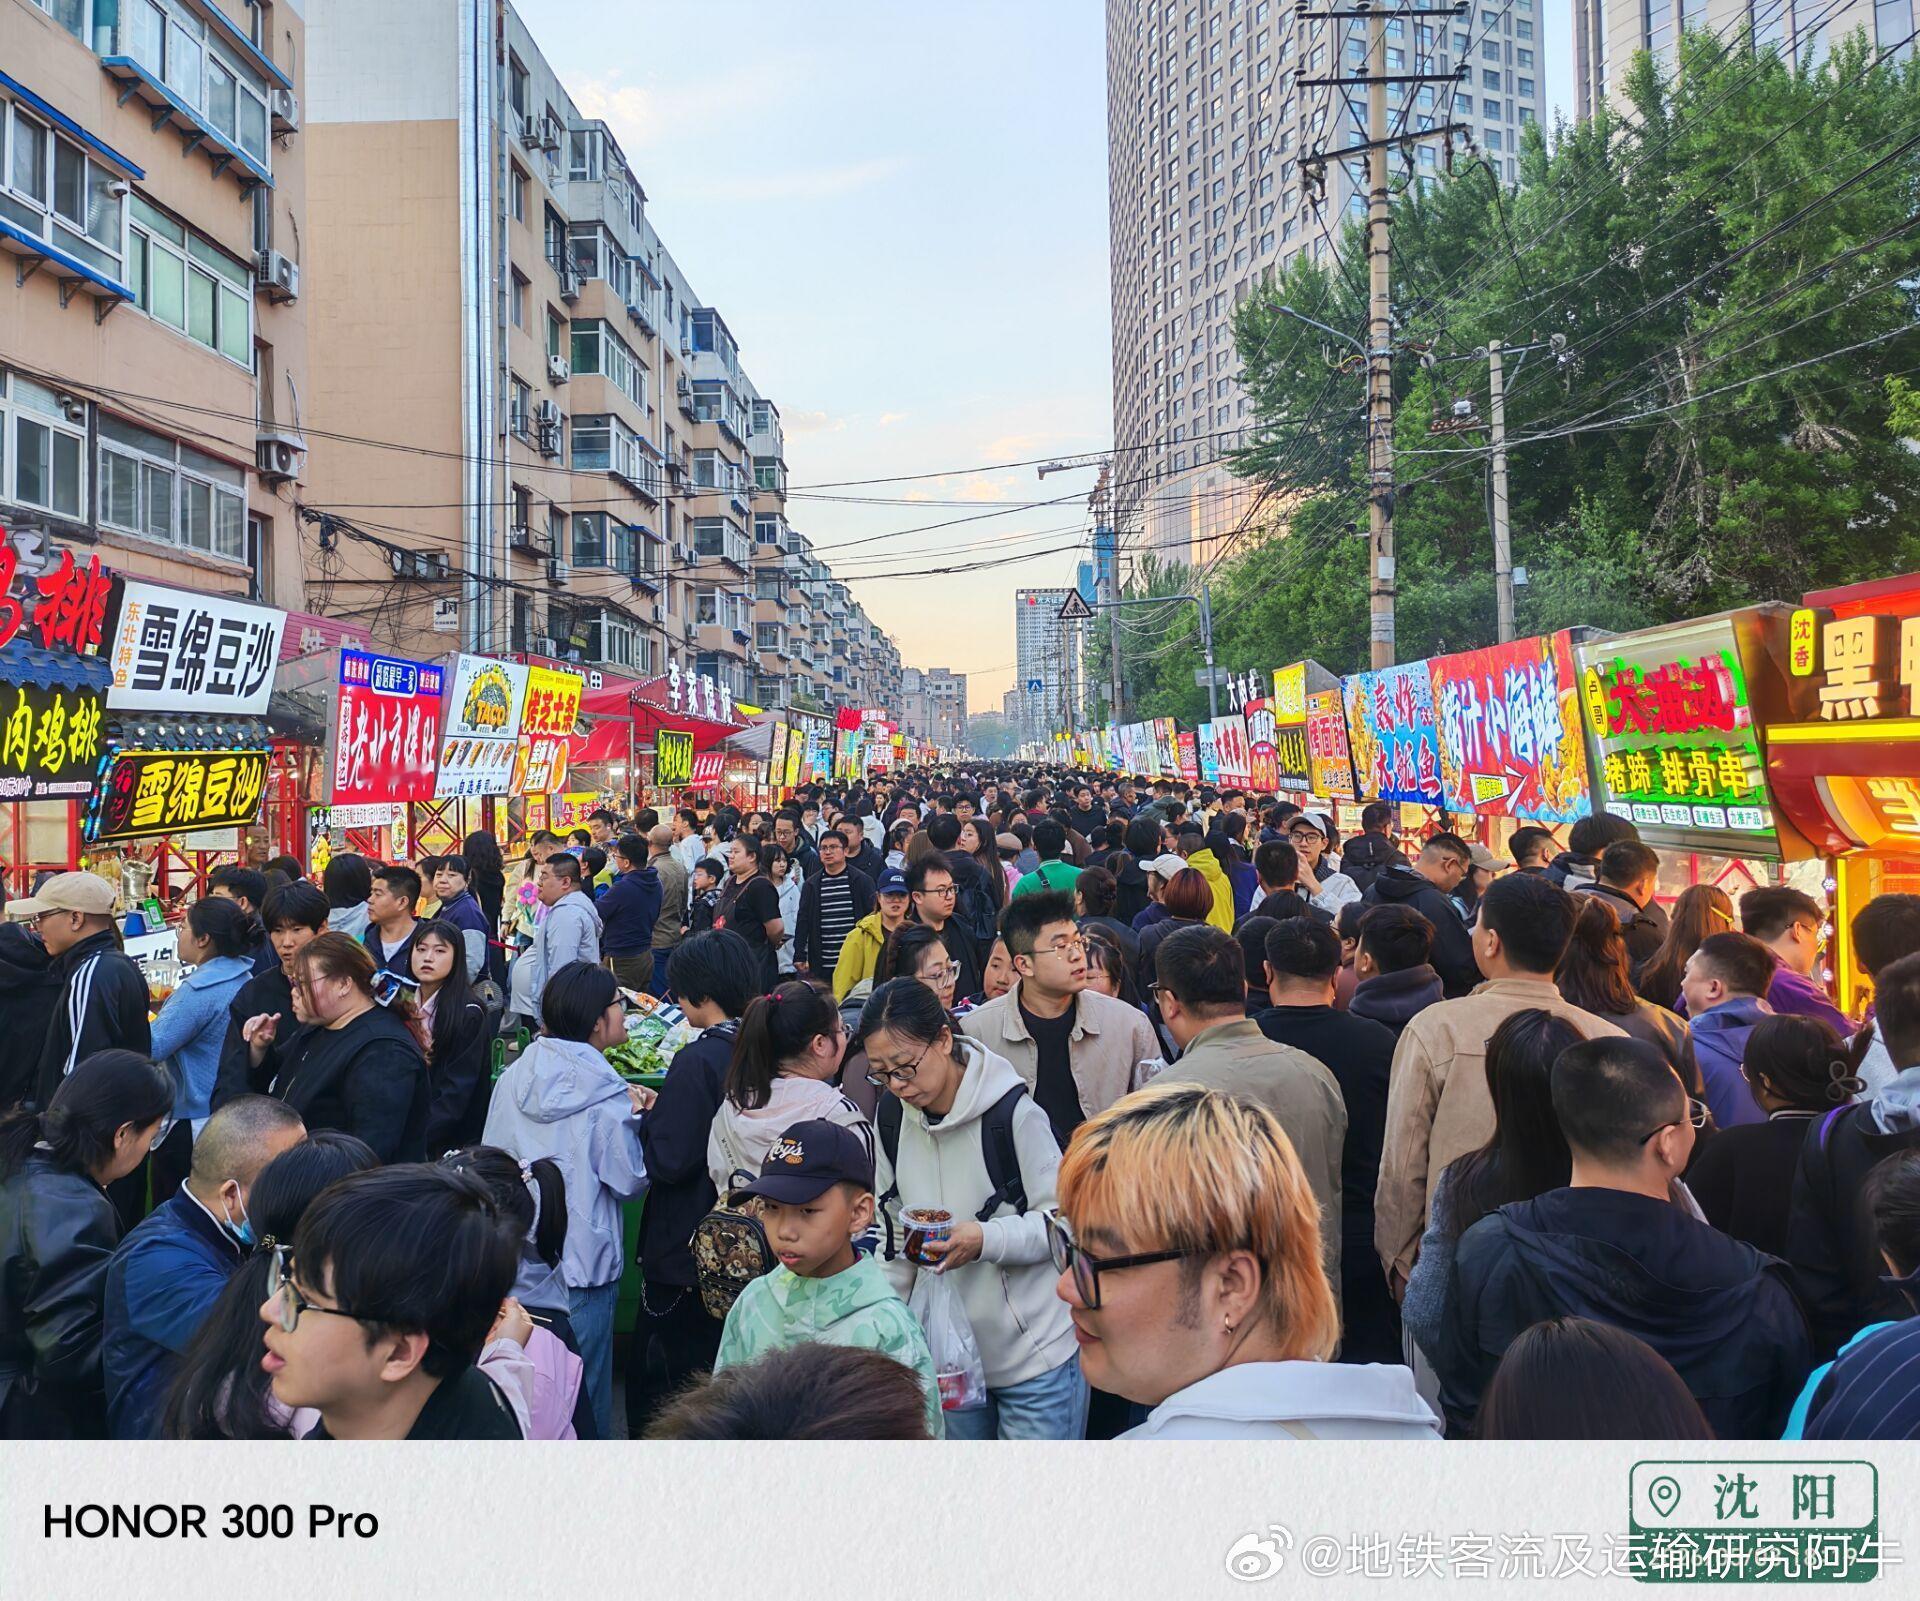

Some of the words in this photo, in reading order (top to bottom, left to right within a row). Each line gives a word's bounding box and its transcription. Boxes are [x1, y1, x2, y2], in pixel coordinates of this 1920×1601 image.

[114, 602, 142, 689] 东北特色
[132, 604, 275, 699] 雪绵豆沙
[1793, 620, 1811, 668] 沈香
[1819, 615, 1920, 721] 黑
[3, 687, 101, 774] 肉鸡排
[476, 700, 506, 725] TACO
[1373, 673, 1419, 734] 轰炸
[131, 757, 262, 828] 雪绵豆沙
[1374, 735, 1442, 799] 大鱿鱼
[1604, 750, 1651, 795] 猪蹄
[1659, 750, 1749, 798] 排骨串
[1662, 808, 1692, 823] 天生吃货
[1729, 813, 1762, 828] 力推产品
